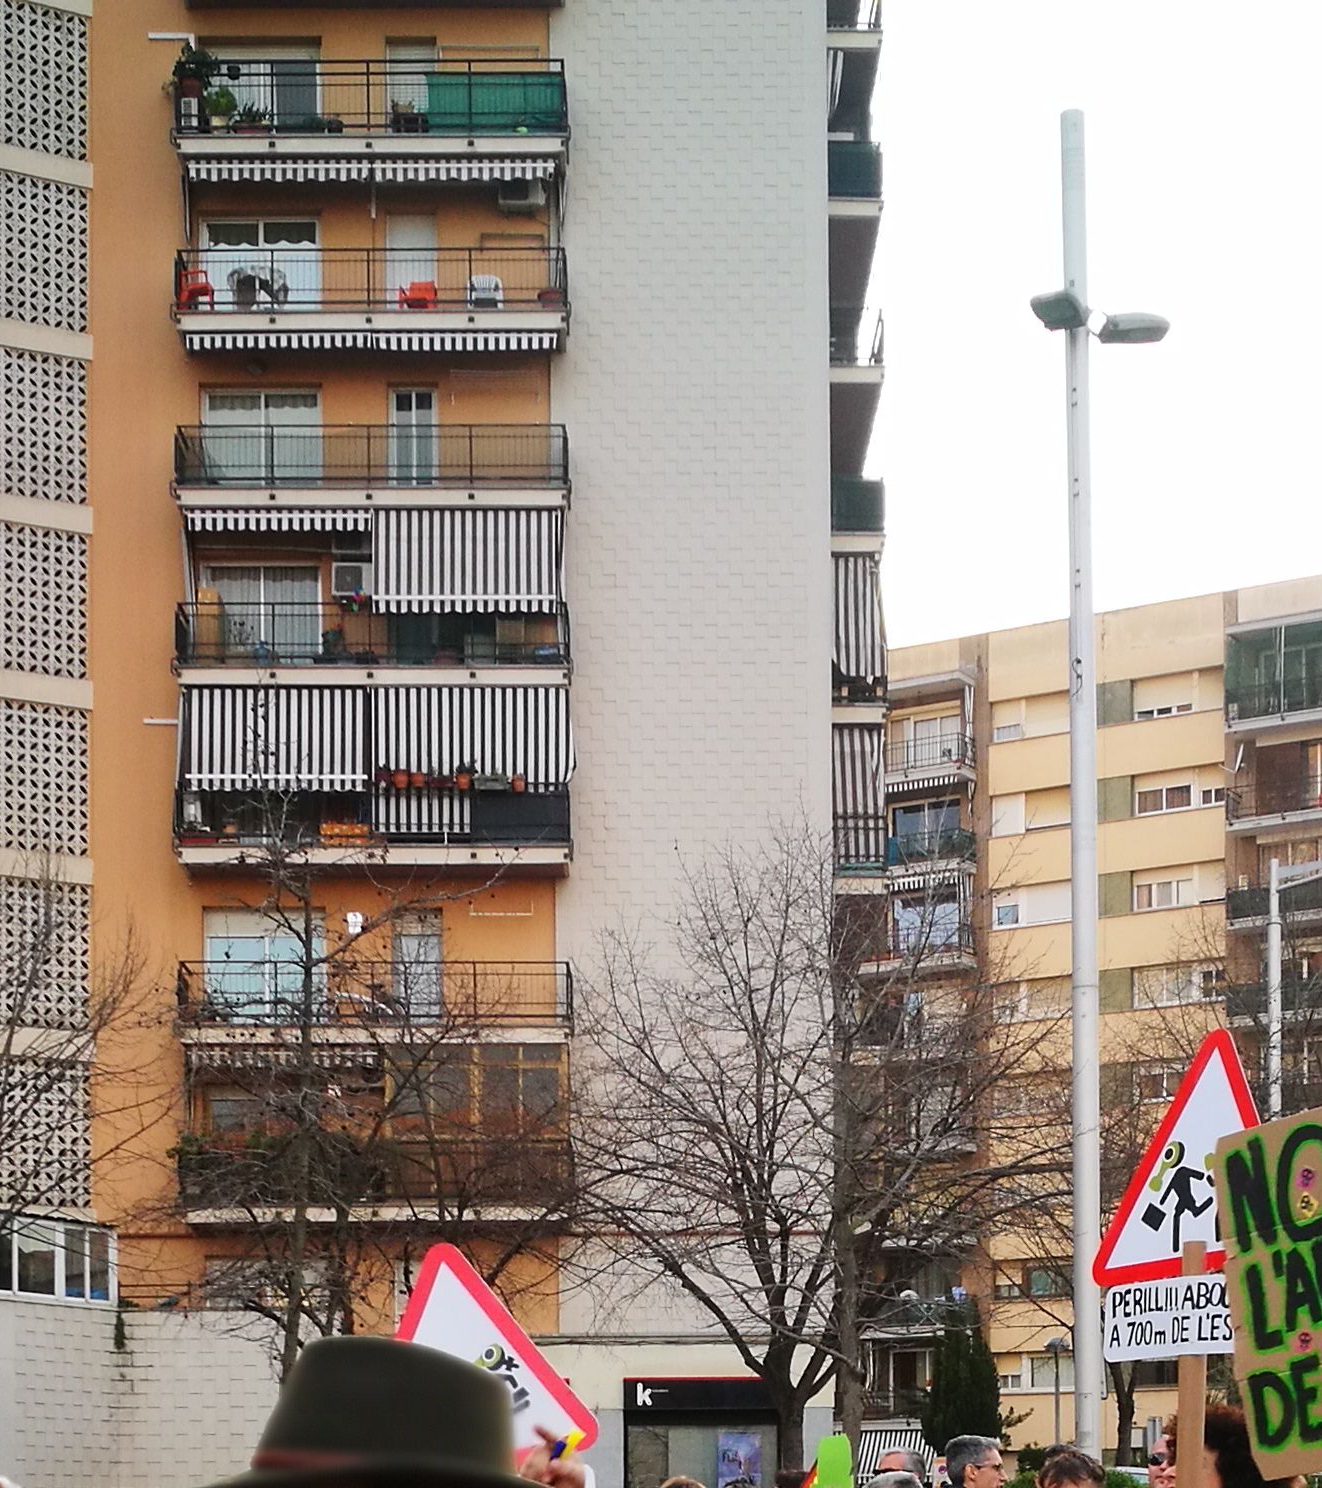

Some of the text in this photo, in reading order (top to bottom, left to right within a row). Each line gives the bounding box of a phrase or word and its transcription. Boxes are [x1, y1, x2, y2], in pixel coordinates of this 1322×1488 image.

[1112, 1281, 1230, 1319] PERILL!!! ABOC
[1109, 1313, 1234, 1348] A 700m DE L'ES
